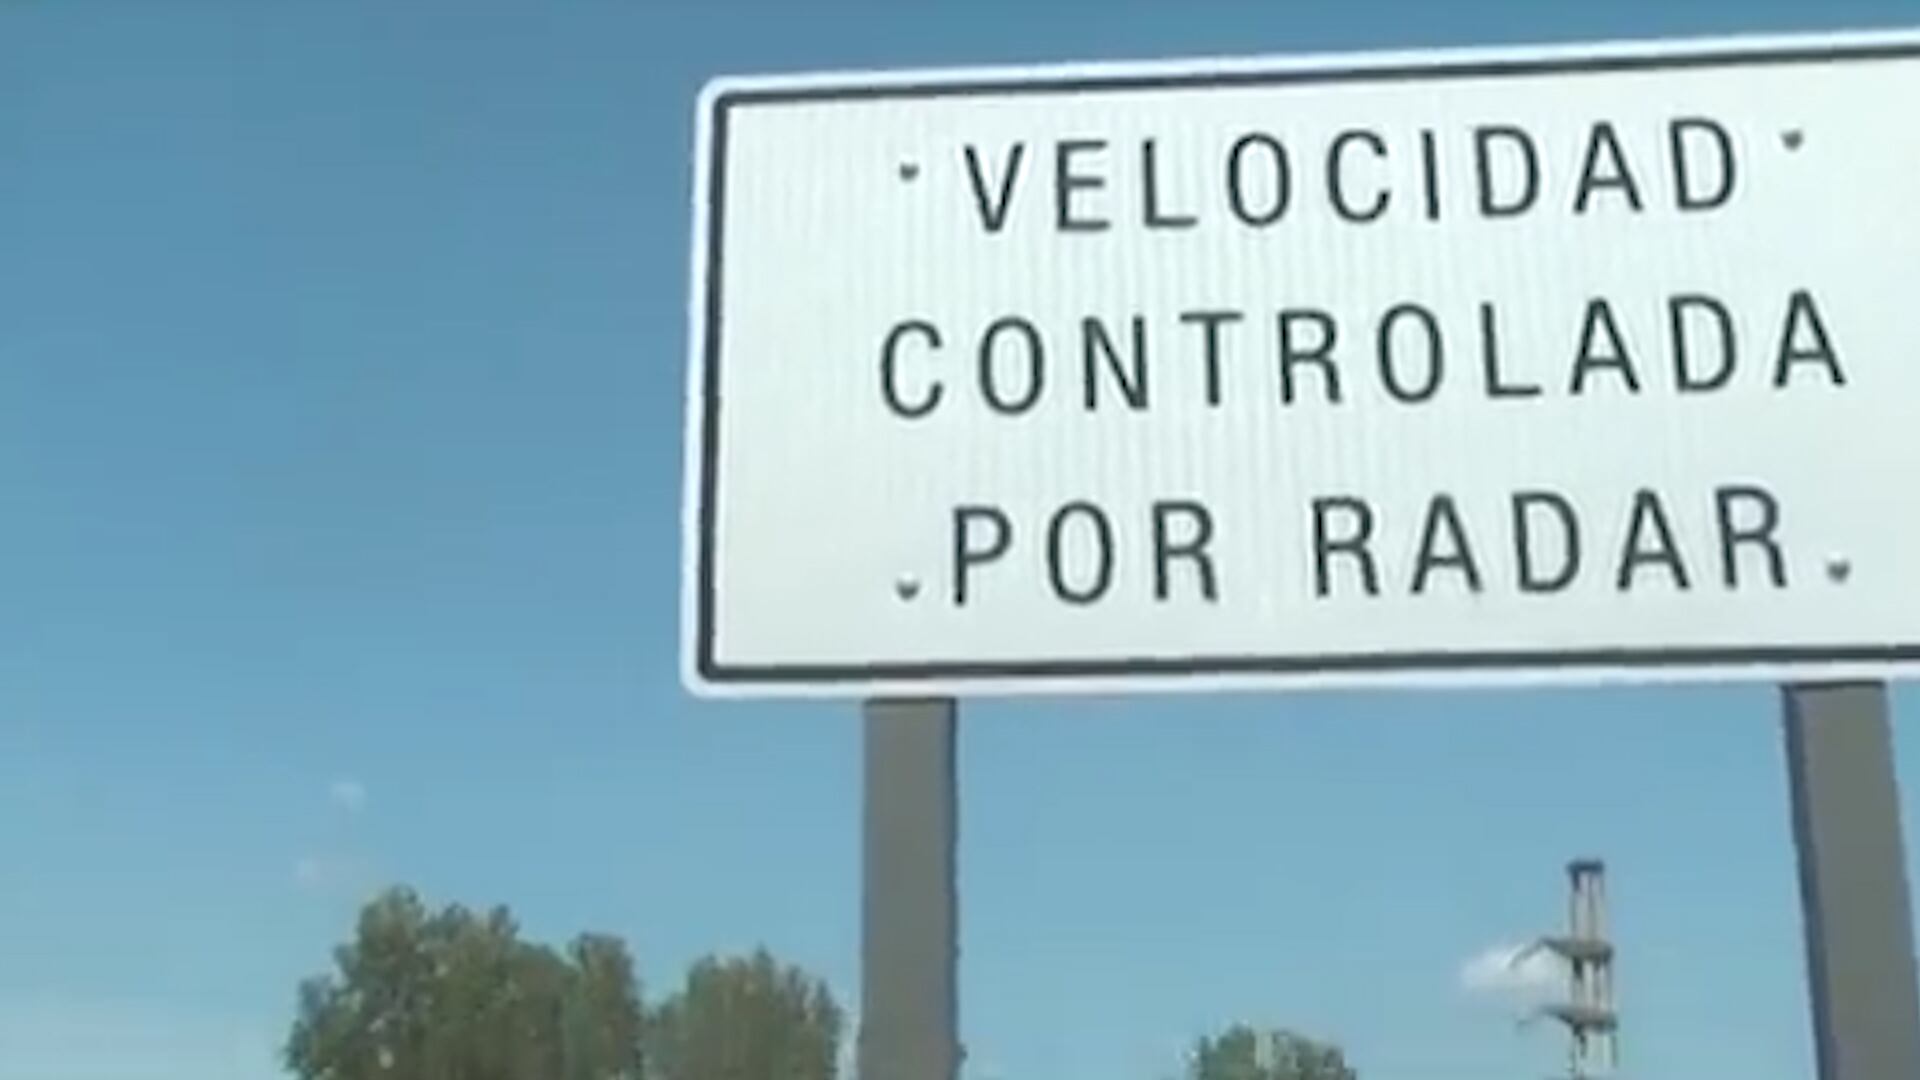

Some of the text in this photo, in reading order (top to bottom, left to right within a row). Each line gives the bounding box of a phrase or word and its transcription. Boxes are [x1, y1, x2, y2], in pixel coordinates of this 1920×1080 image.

[963, 117, 1738, 233] VELOCIDAD
[880, 290, 1847, 419] CONTROLADA
[952, 485, 1789, 607] POR RADAR
